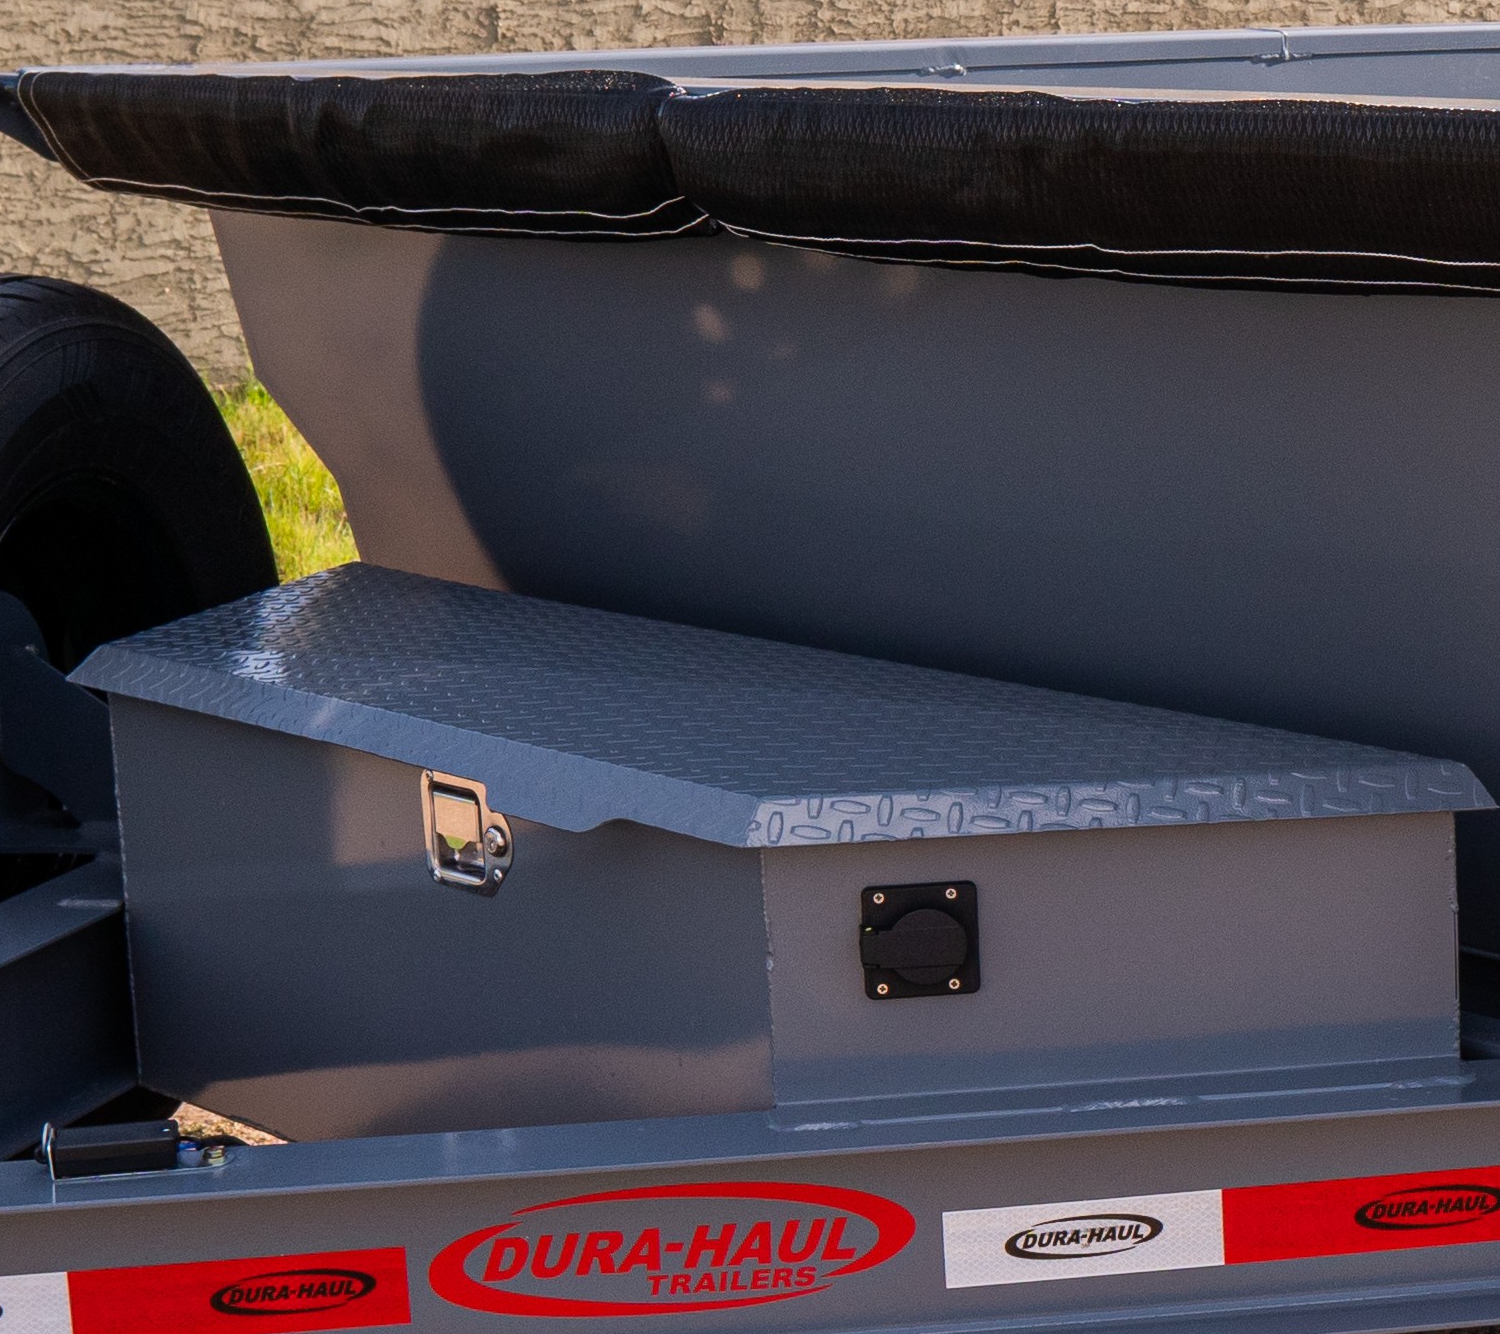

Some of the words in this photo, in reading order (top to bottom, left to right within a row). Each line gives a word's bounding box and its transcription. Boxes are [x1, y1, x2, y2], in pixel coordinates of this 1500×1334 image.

[1371, 1194, 1491, 1219] DURA-HAUL
[480, 1215, 858, 1284] DURA-HAUL
[1022, 1223, 1145, 1251] DURA-HAUL
[226, 1279, 358, 1307] DURA-HAUL
[646, 1266, 818, 1297] TRAILERS
